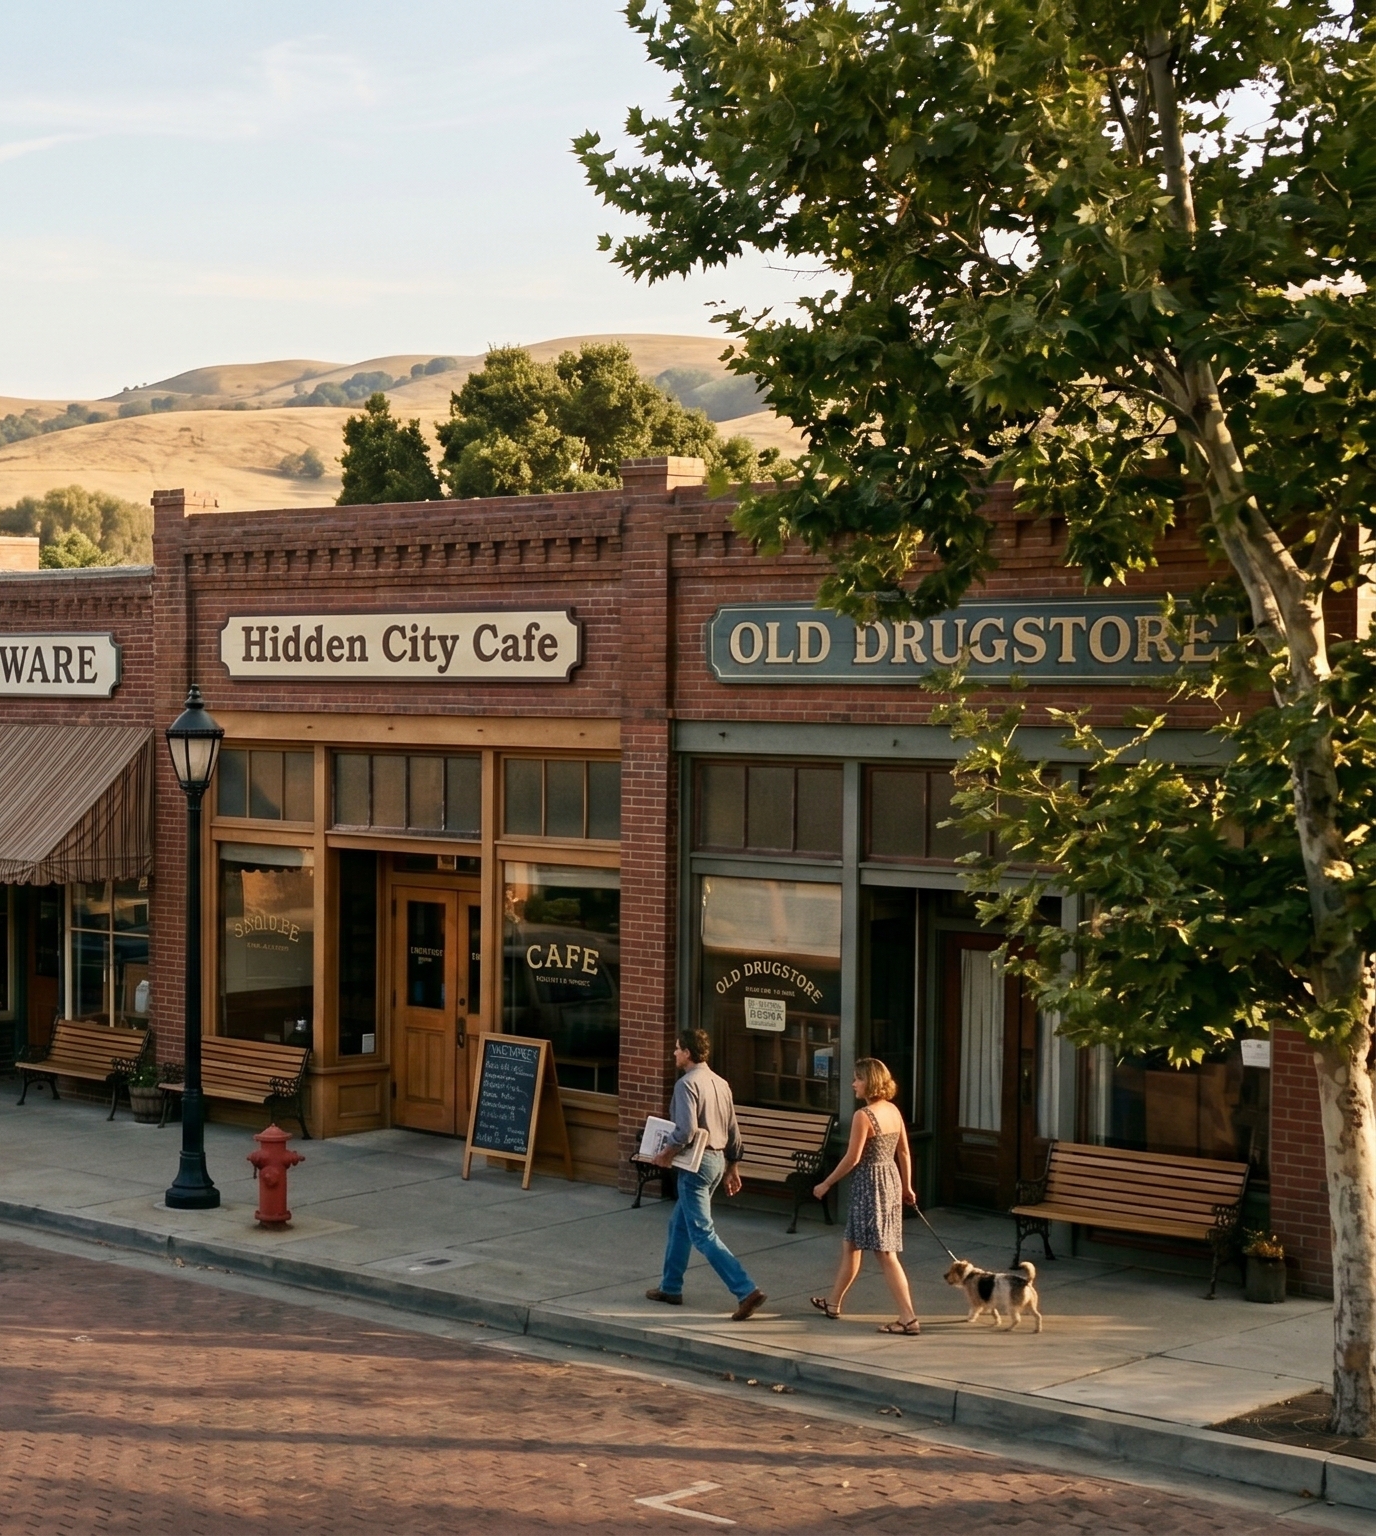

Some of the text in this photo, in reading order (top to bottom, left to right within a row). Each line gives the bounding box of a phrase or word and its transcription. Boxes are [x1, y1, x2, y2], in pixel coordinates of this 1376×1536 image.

[240, 621, 558, 674] Hidden City Cafe
[729, 615, 1220, 665] OLD DRUGSTORE
[526, 943, 599, 976] CAFE
[715, 960, 823, 1004] OLD DRUGSTORE
